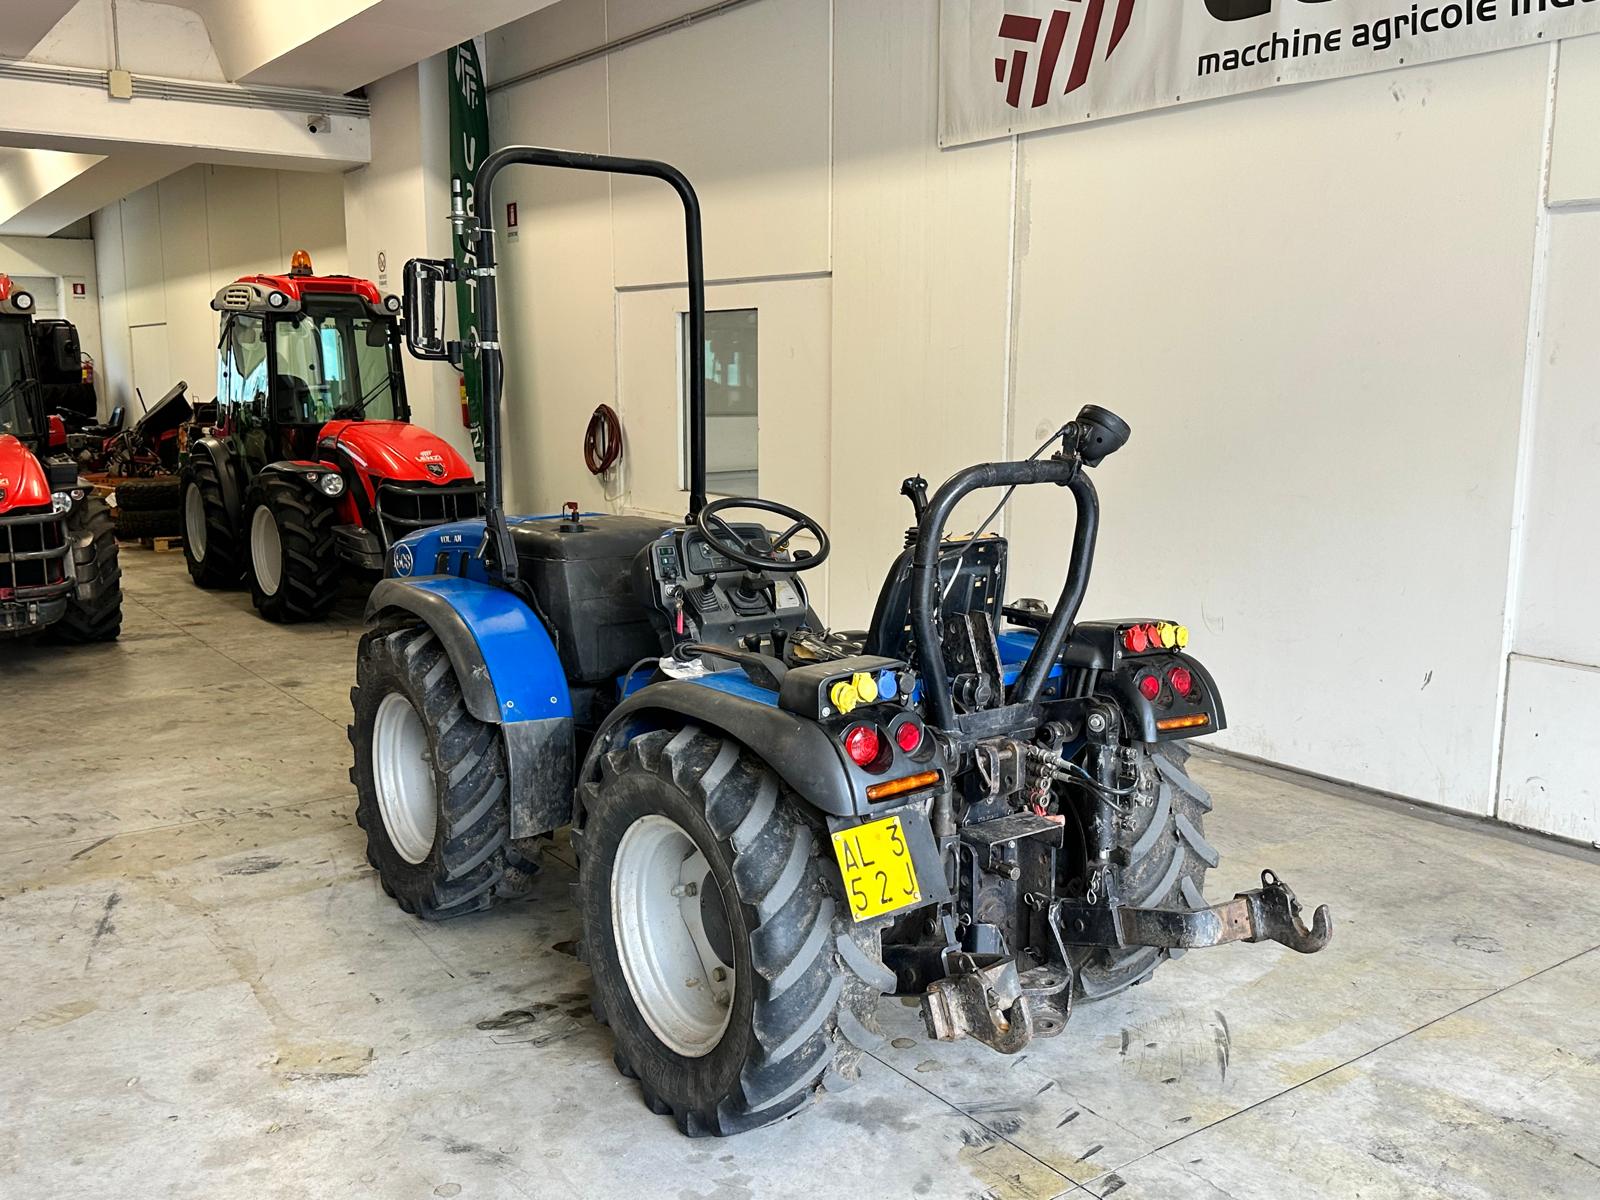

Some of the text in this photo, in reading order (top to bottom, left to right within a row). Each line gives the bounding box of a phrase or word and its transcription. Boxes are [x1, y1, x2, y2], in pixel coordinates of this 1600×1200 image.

[1198, 29, 1341, 76] macchine
[1352, 0, 1496, 51] agricole
[843, 824, 904, 872] AL 3
